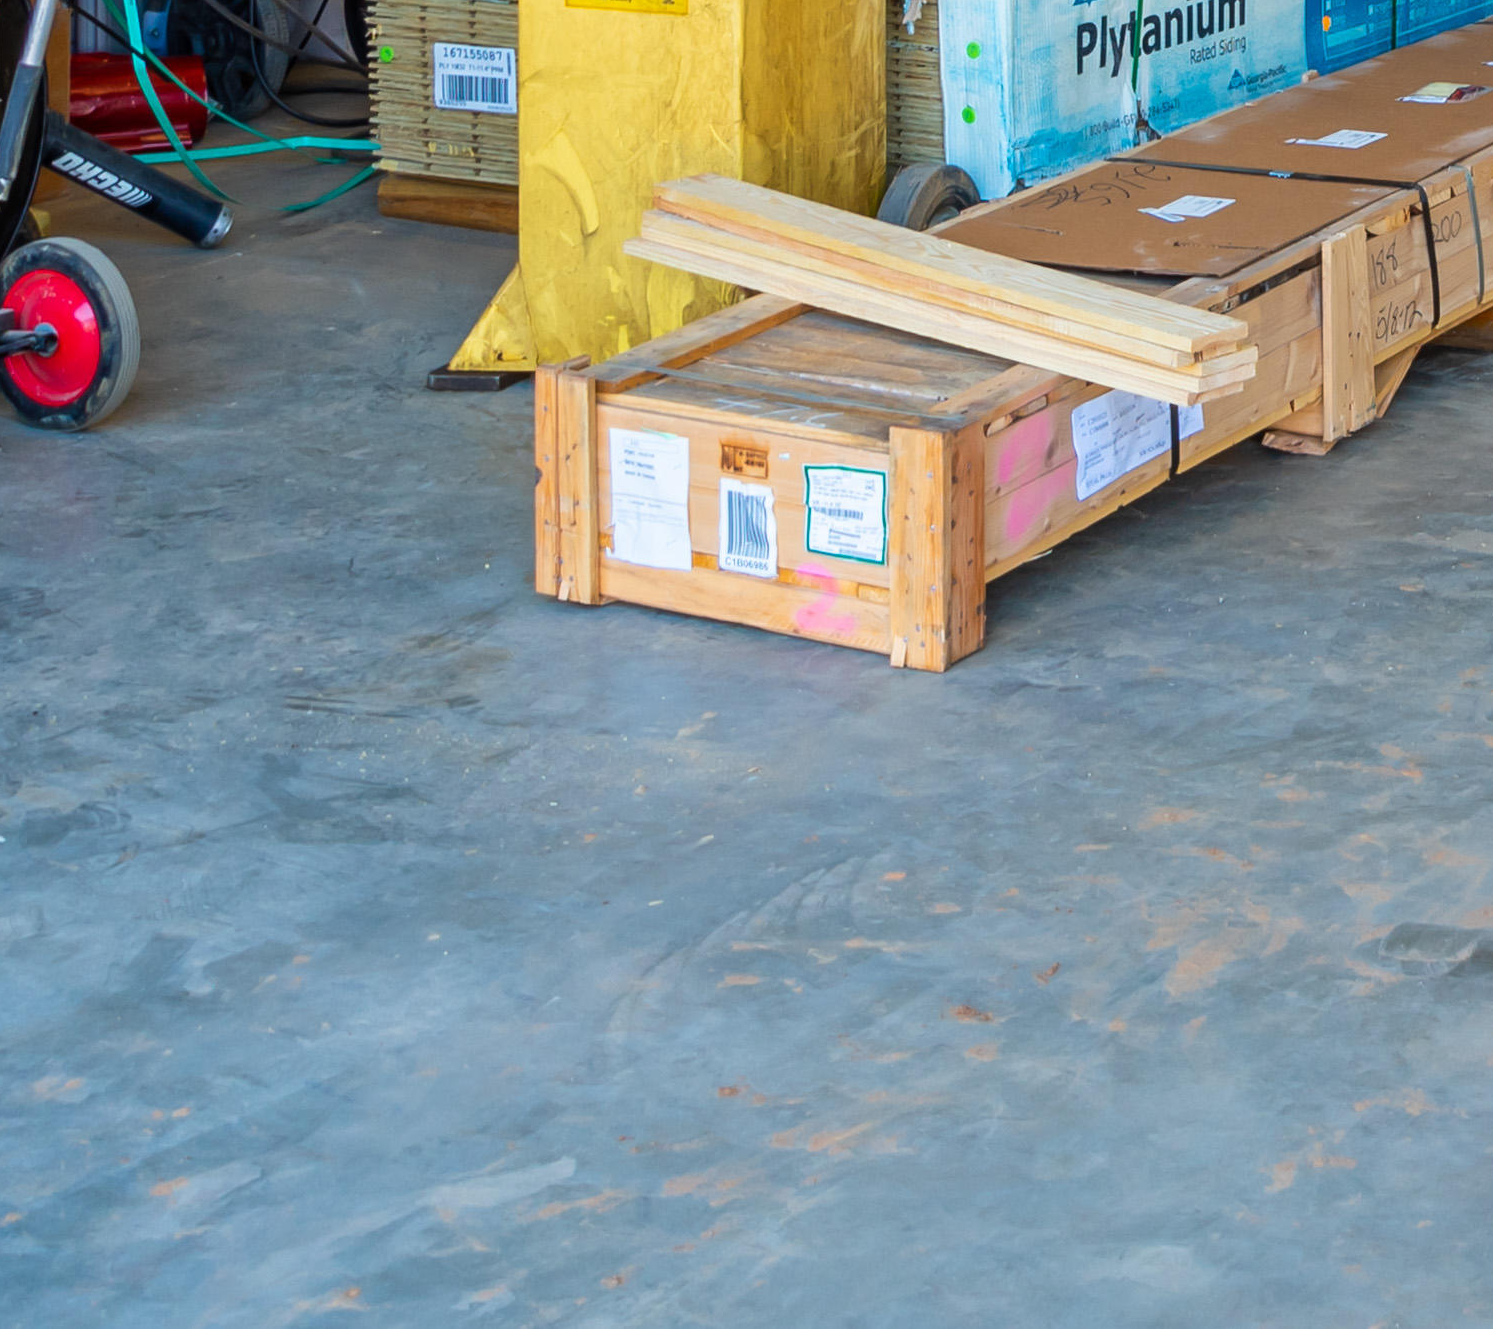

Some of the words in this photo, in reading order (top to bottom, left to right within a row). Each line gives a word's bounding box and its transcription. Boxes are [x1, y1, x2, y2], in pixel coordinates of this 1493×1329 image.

[443, 47, 502, 61] 167155087
[1189, 39, 1217, 65] Rated
[1219, 36, 1246, 56] Siding
[52, 152, 134, 199] ECHO
